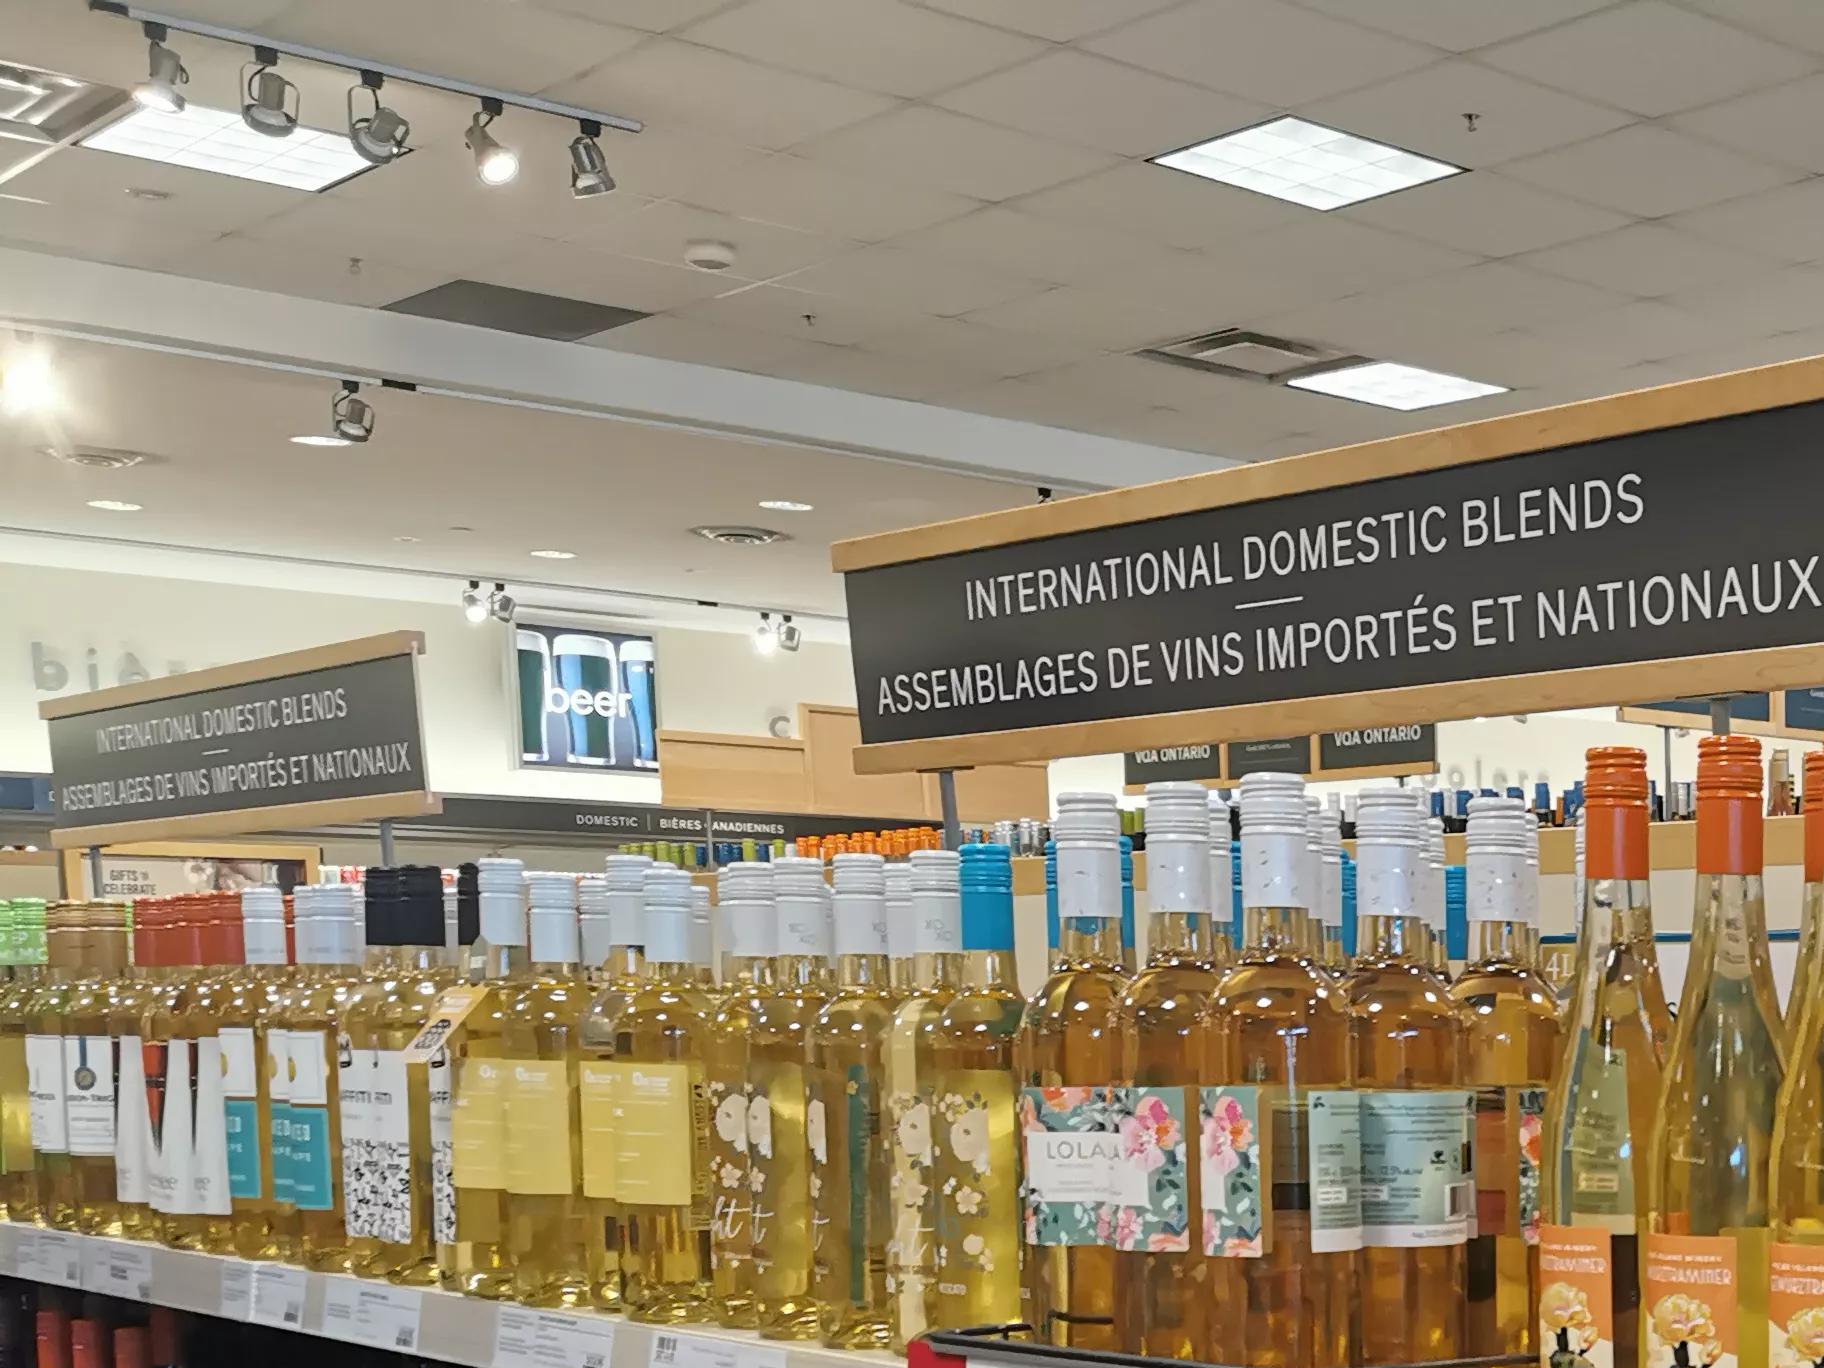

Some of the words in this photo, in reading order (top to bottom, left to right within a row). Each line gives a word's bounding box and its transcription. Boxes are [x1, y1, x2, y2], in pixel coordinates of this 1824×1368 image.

[965, 542, 1231, 621] INTERNATIONAL
[1243, 506, 1446, 581] DOMESTIC
[1462, 473, 1646, 543] BLENDS
[877, 653, 1098, 715] ASSEMBLAGES
[1109, 638, 1152, 687] DE
[1160, 631, 1243, 680] VINS
[1256, 595, 1457, 673] IMPORTÉS
[1471, 596, 1516, 648] ET
[1537, 554, 1823, 639] NATIONAUX
[545, 687, 632, 718] beer
[96, 714, 201, 754] INTERNATIONAL
[202, 700, 278, 738] DOMESTIC
[283, 688, 347, 722] BLENDS
[1334, 727, 1361, 747] VQA
[1365, 724, 1421, 744] ONTARIO
[1161, 744, 1210, 762] ONTARIO
[63, 775, 153, 811] ASSEMBLAGES
[155, 774, 174, 800] DE
[176, 768, 209, 799] VINS
[211, 752, 286, 793] IMPORTÉS
[289, 755, 308, 785] ET
[312, 742, 411, 781] NATIONAUX
[576, 814, 638, 828] DOMESTIC
[659, 817, 701, 831] BIÈRES
[703, 821, 784, 835] ANADIENNES
[109, 869, 138, 883] GIFTS
[103, 881, 156, 896] CELEBRATE
[1045, 1140, 1105, 1161] LOLA
